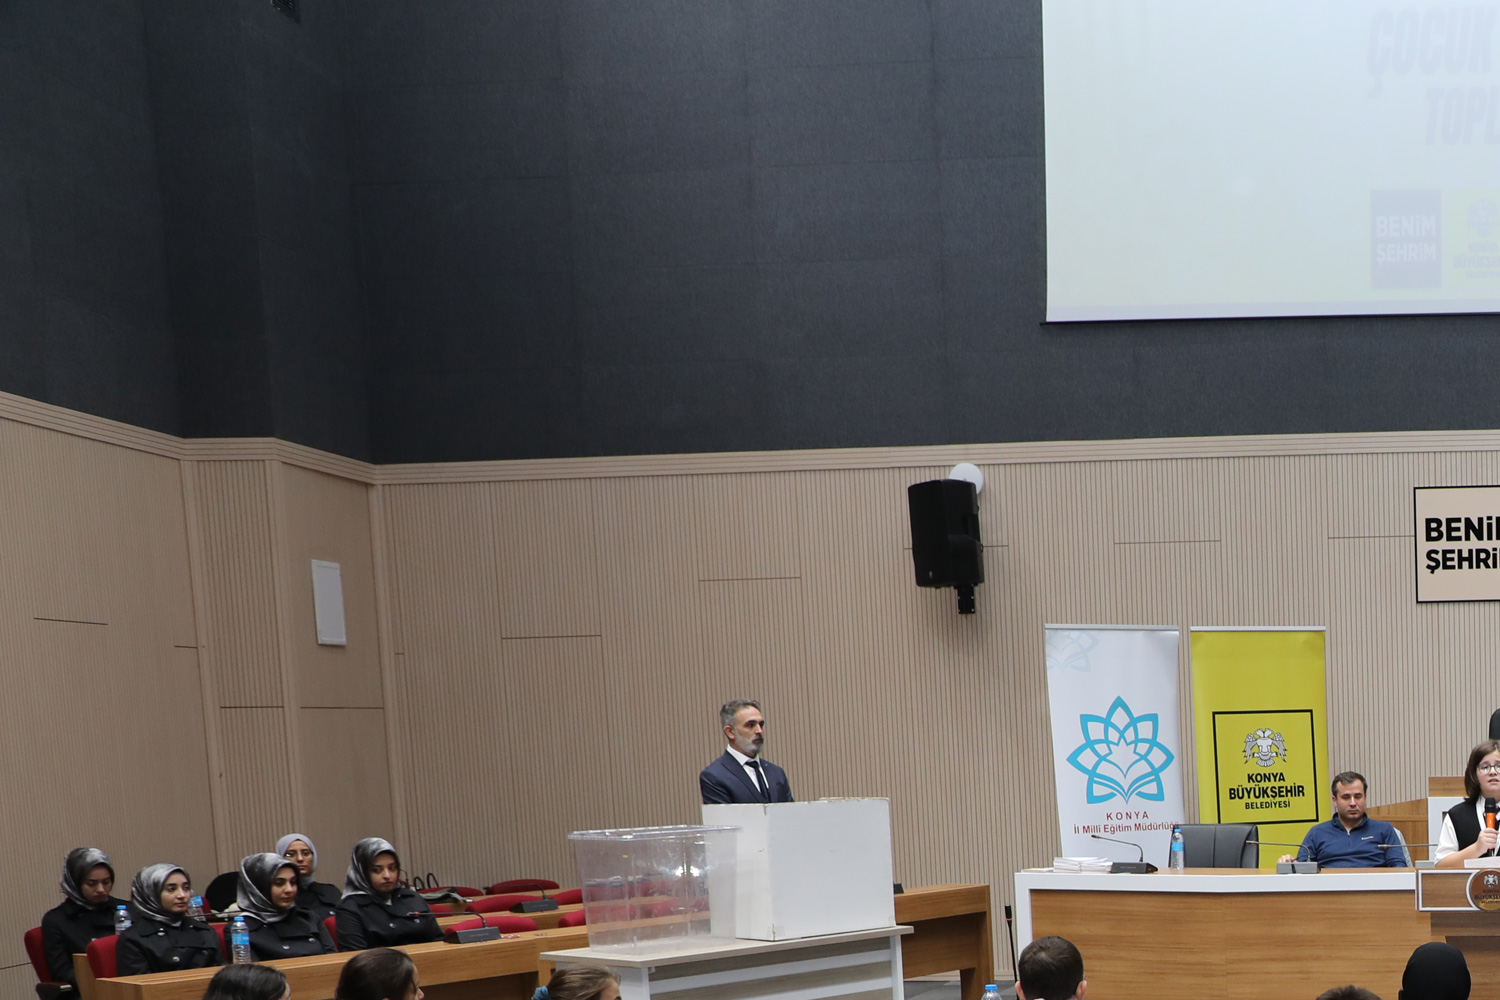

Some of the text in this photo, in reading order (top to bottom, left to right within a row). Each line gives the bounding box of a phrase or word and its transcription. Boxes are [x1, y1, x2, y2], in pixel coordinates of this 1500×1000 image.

[1366, 5, 1498, 98] ÇOCUK
[1247, 772, 1286, 783] KONYA
[1229, 783, 1305, 800] BÜYÜKŞEHİR
[1245, 799, 1291, 810] BELEDİYESİ
[1106, 811, 1149, 821] KONYA
[1103, 824, 1132, 834] Eğitim
[1134, 821, 1178, 832] Müdürlüğ
